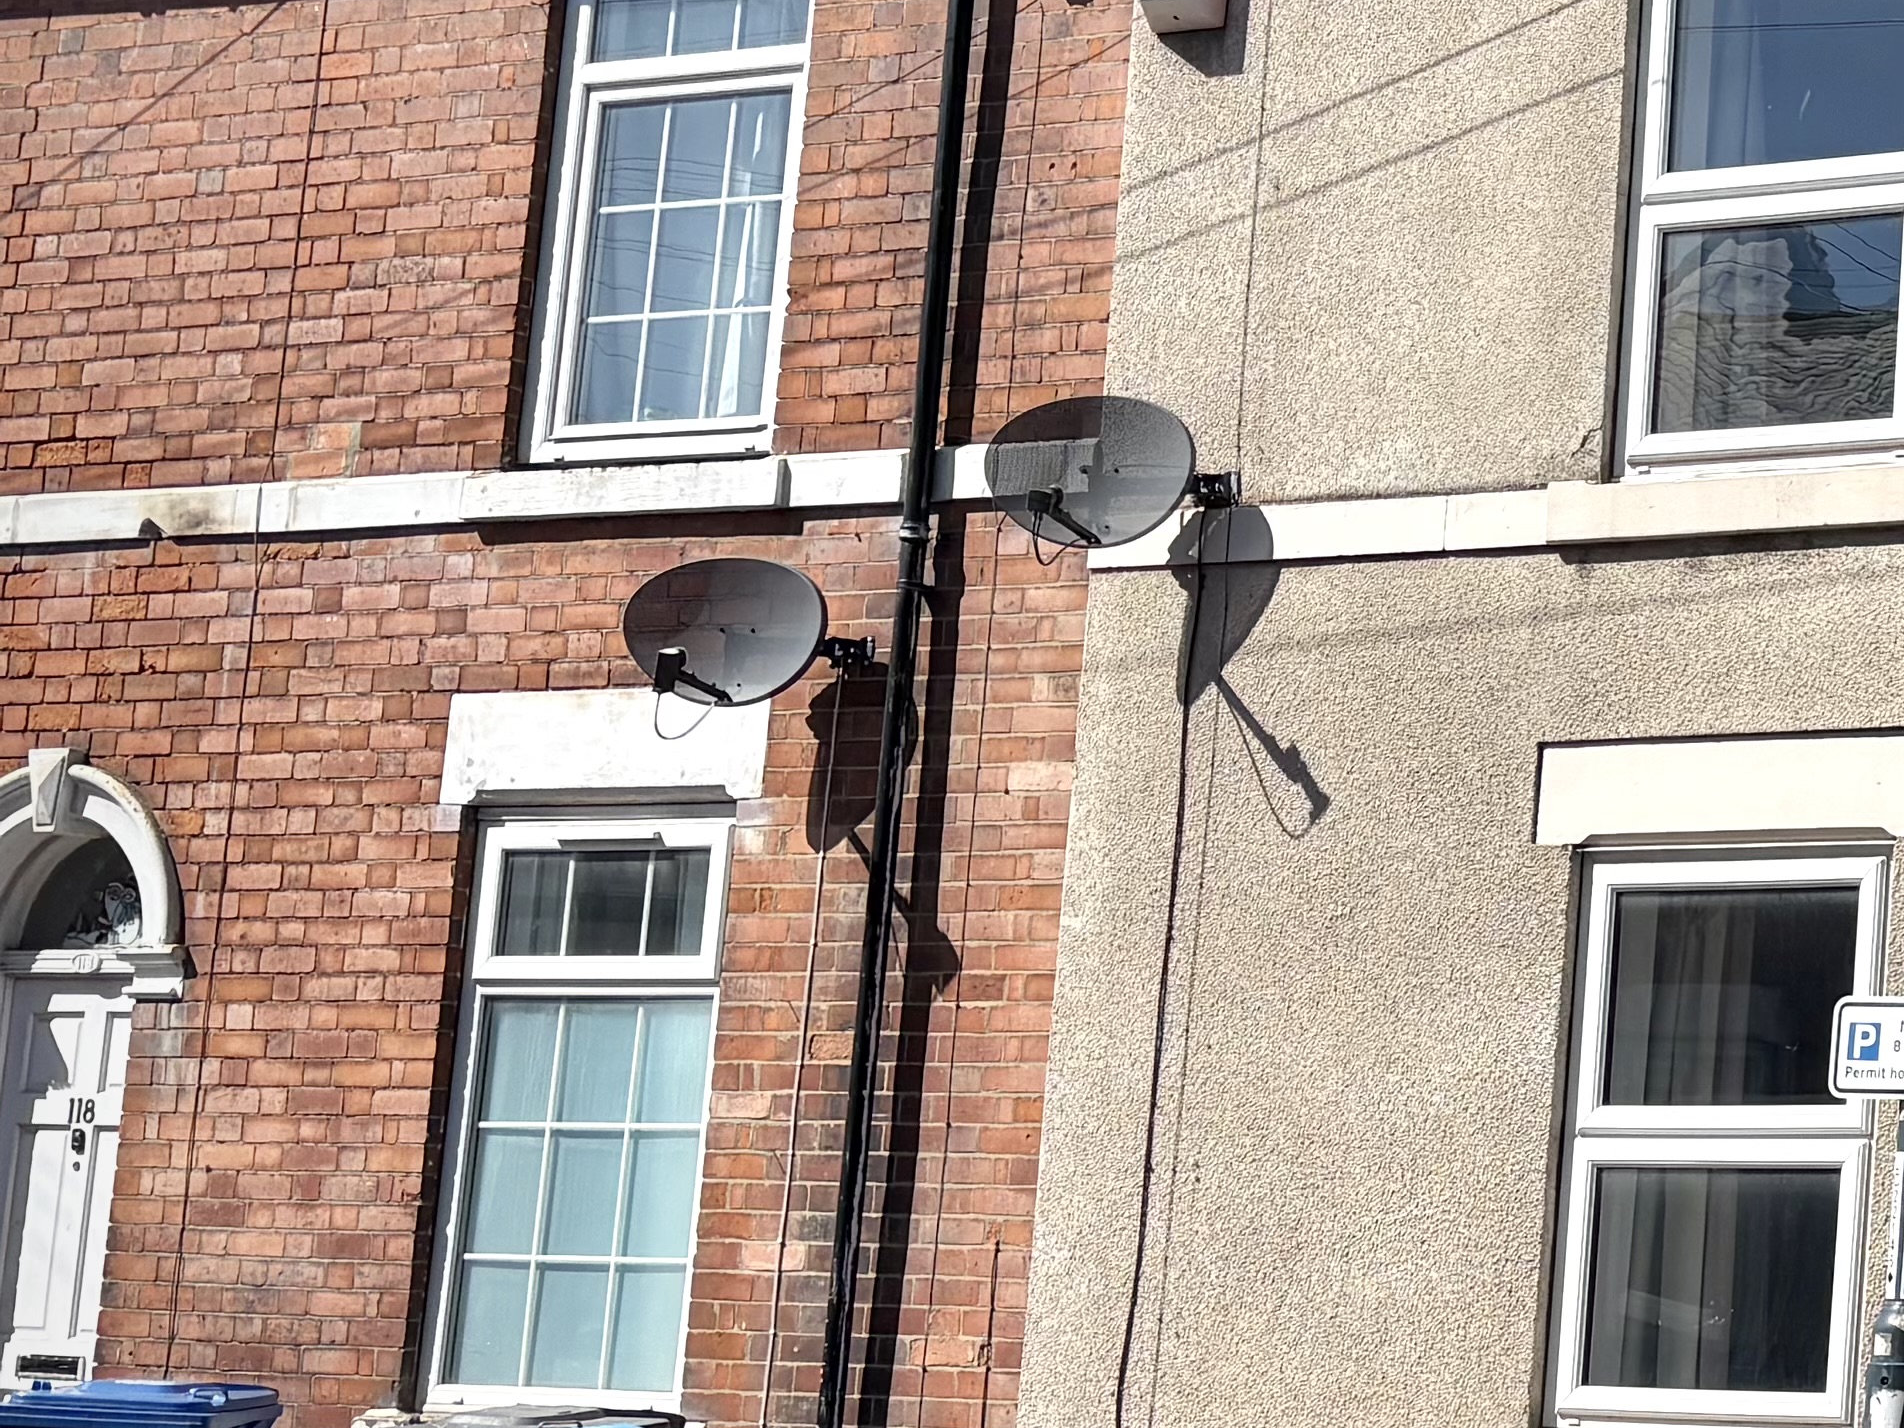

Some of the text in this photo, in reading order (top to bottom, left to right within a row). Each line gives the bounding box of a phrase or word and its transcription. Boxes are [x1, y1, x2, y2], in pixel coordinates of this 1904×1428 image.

[1853, 1024, 1877, 1059] P
[1845, 1066, 1886, 1079] Permit
[67, 1097, 95, 1124] 118
